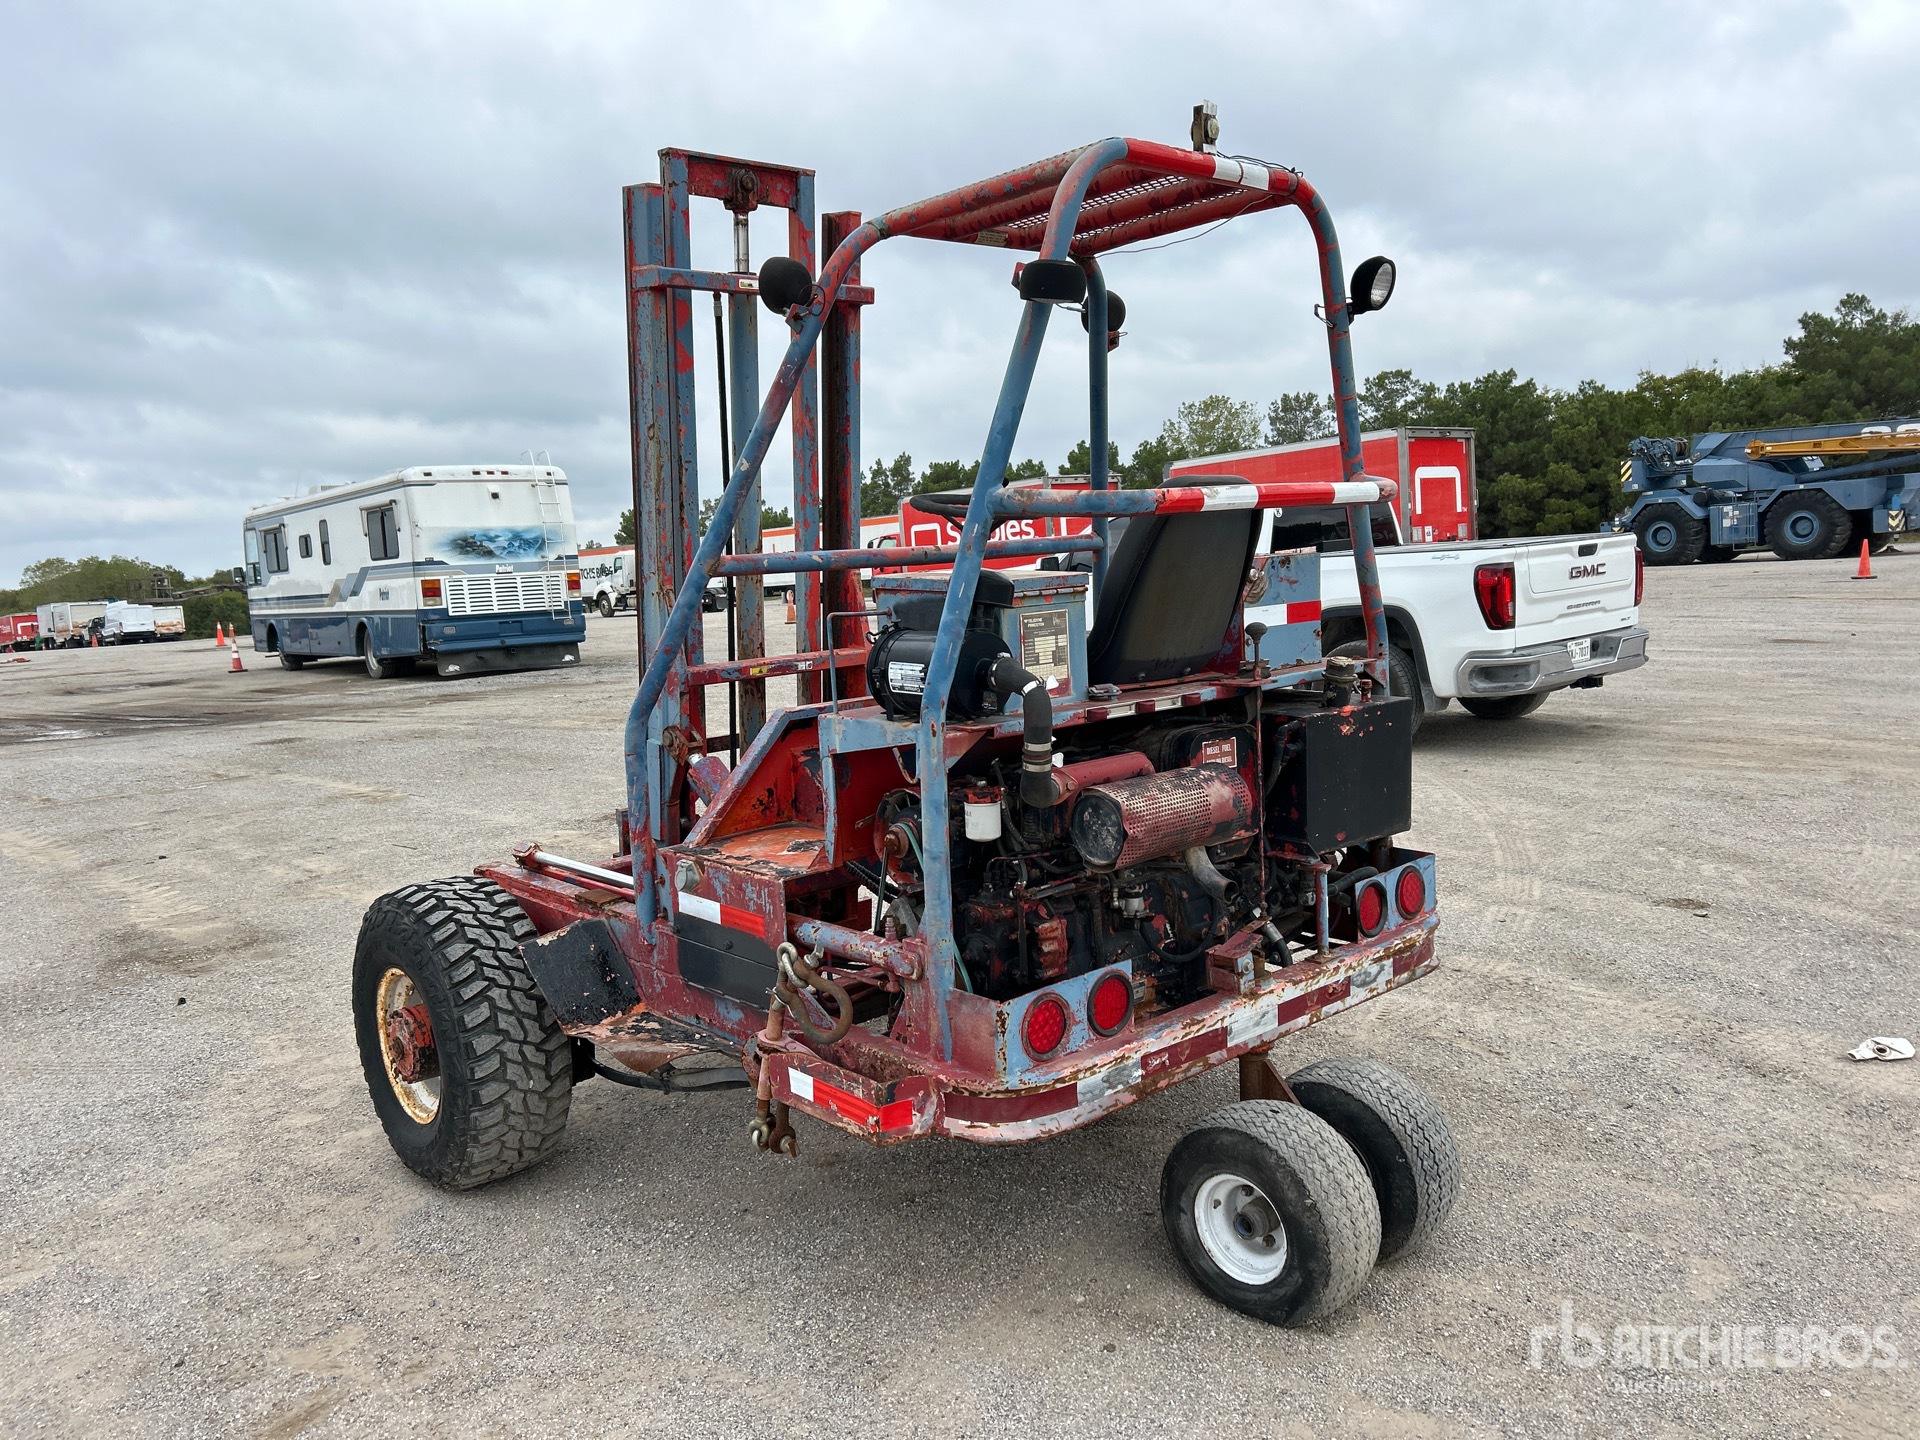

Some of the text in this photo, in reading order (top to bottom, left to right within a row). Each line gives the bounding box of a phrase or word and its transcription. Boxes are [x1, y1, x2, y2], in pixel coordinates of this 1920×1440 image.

[946, 519, 1035, 546] Sles
[495, 563, 514, 573] Patriot
[1569, 563, 1606, 580] GMC
[1566, 599, 1601, 610] SIERRA
[1207, 744, 1232, 755] DIESEL FUEL
